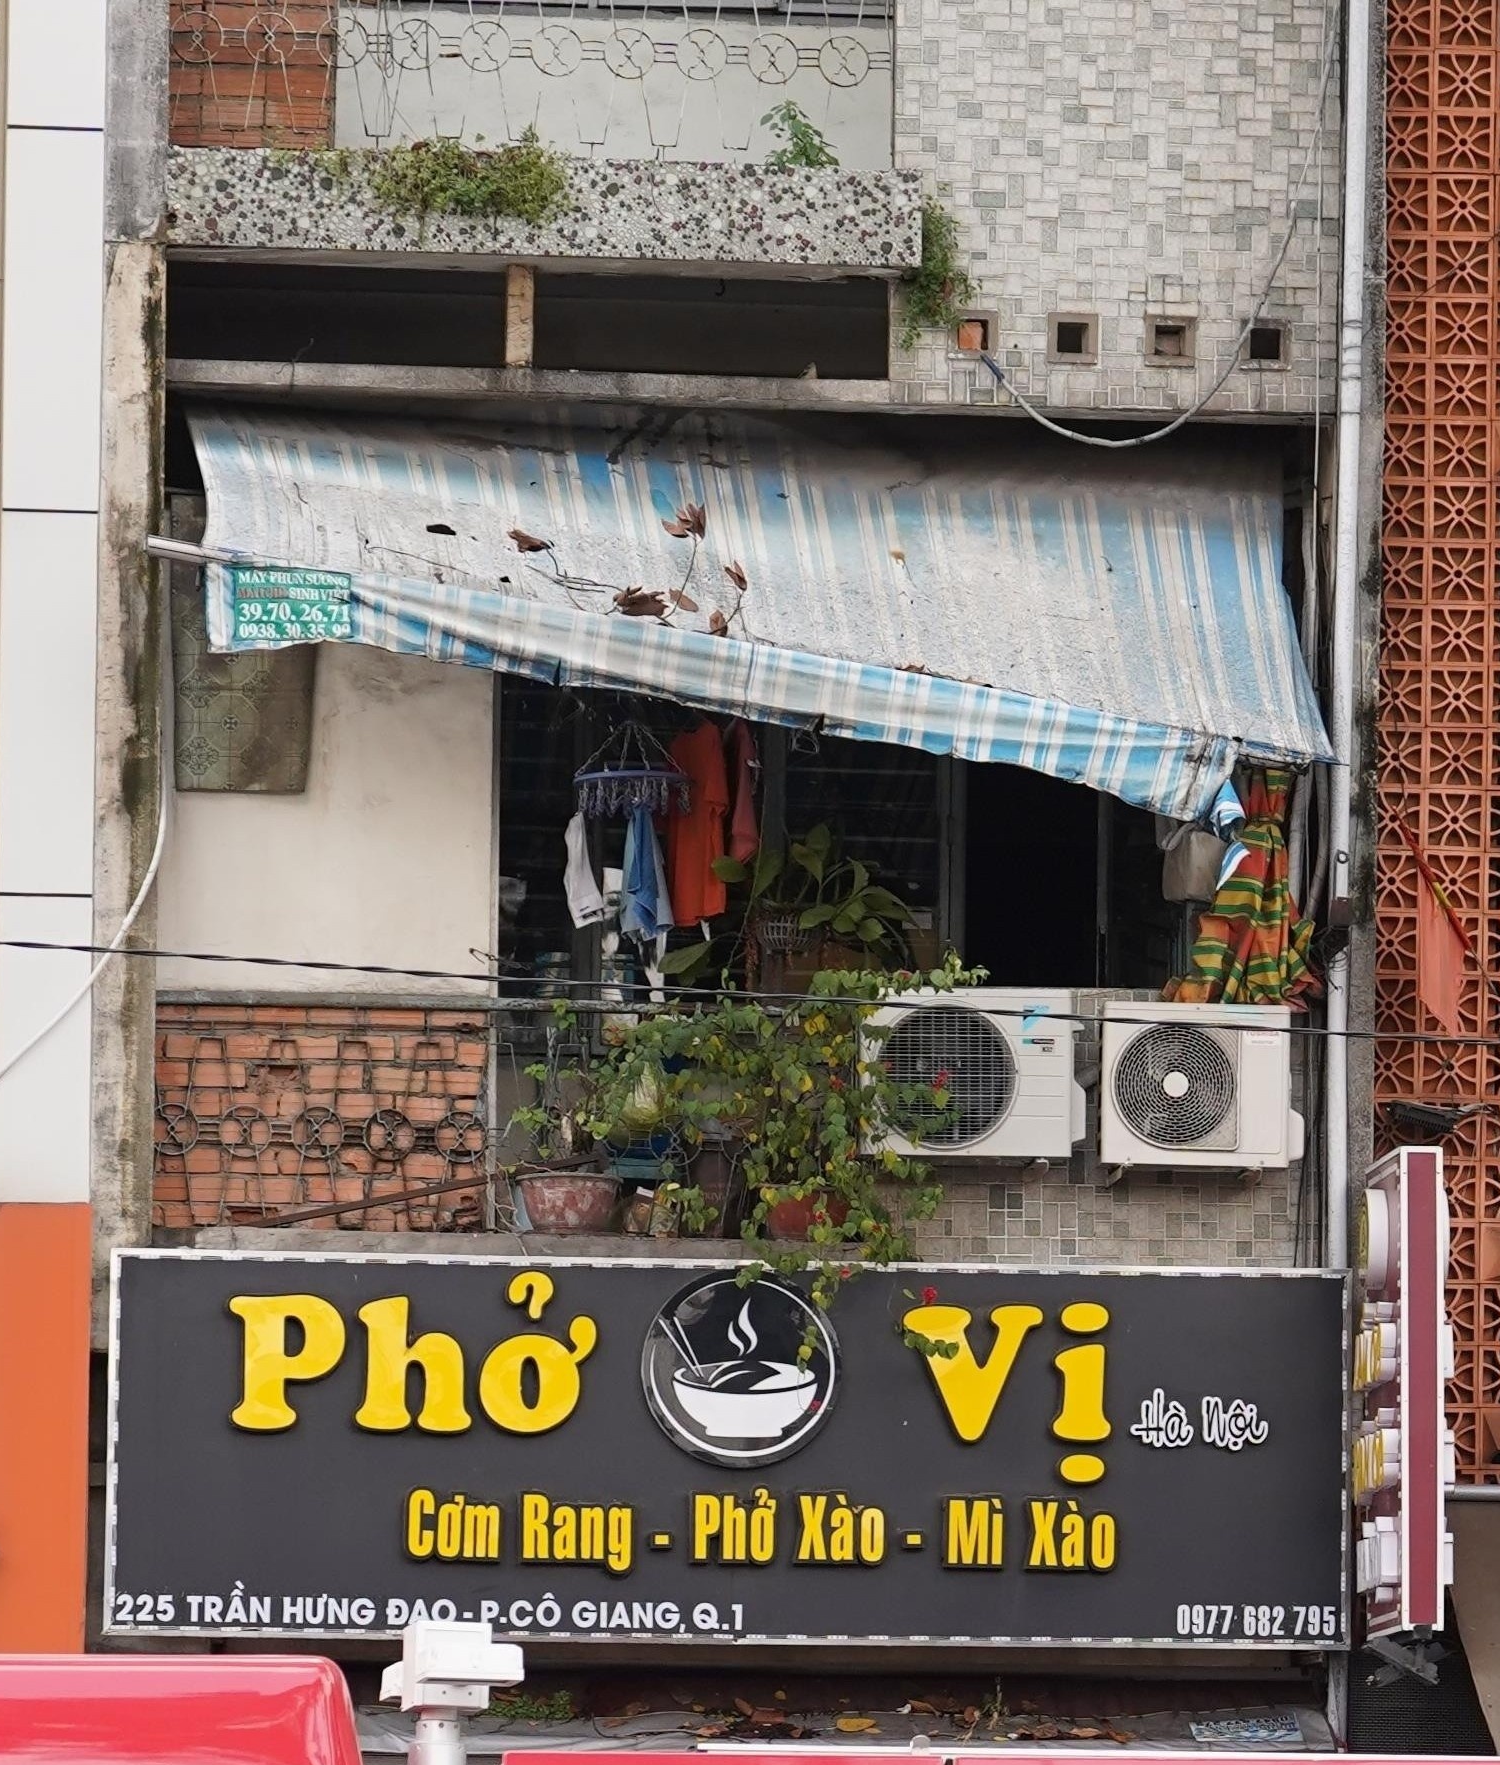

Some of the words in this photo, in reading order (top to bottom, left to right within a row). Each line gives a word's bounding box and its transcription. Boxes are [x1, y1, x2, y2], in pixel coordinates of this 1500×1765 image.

[227, 1270, 598, 1434] Phở
[902, 1301, 1112, 1484] Vị
[1129, 1386, 1194, 1448] Hà
[1201, 1396, 1269, 1451] Nội
[405, 1487, 501, 1563] Cơm
[520, 1492, 634, 1573] Rang
[693, 1487, 776, 1563] Phở
[797, 1492, 886, 1564] Xào
[946, 1492, 1004, 1567] Mì
[1028, 1497, 1116, 1572] Xào
[116, 1593, 175, 1623] 225
[186, 1580, 271, 1623] TRẦN
[282, 1592, 376, 1625] HƯNG
[572, 1600, 686, 1632] GIANG,
[692, 1602, 745, 1633] Q.1
[1176, 1604, 1233, 1636] 0977
[1243, 1605, 1285, 1636] 682
[1293, 1606, 1336, 1636] 795
